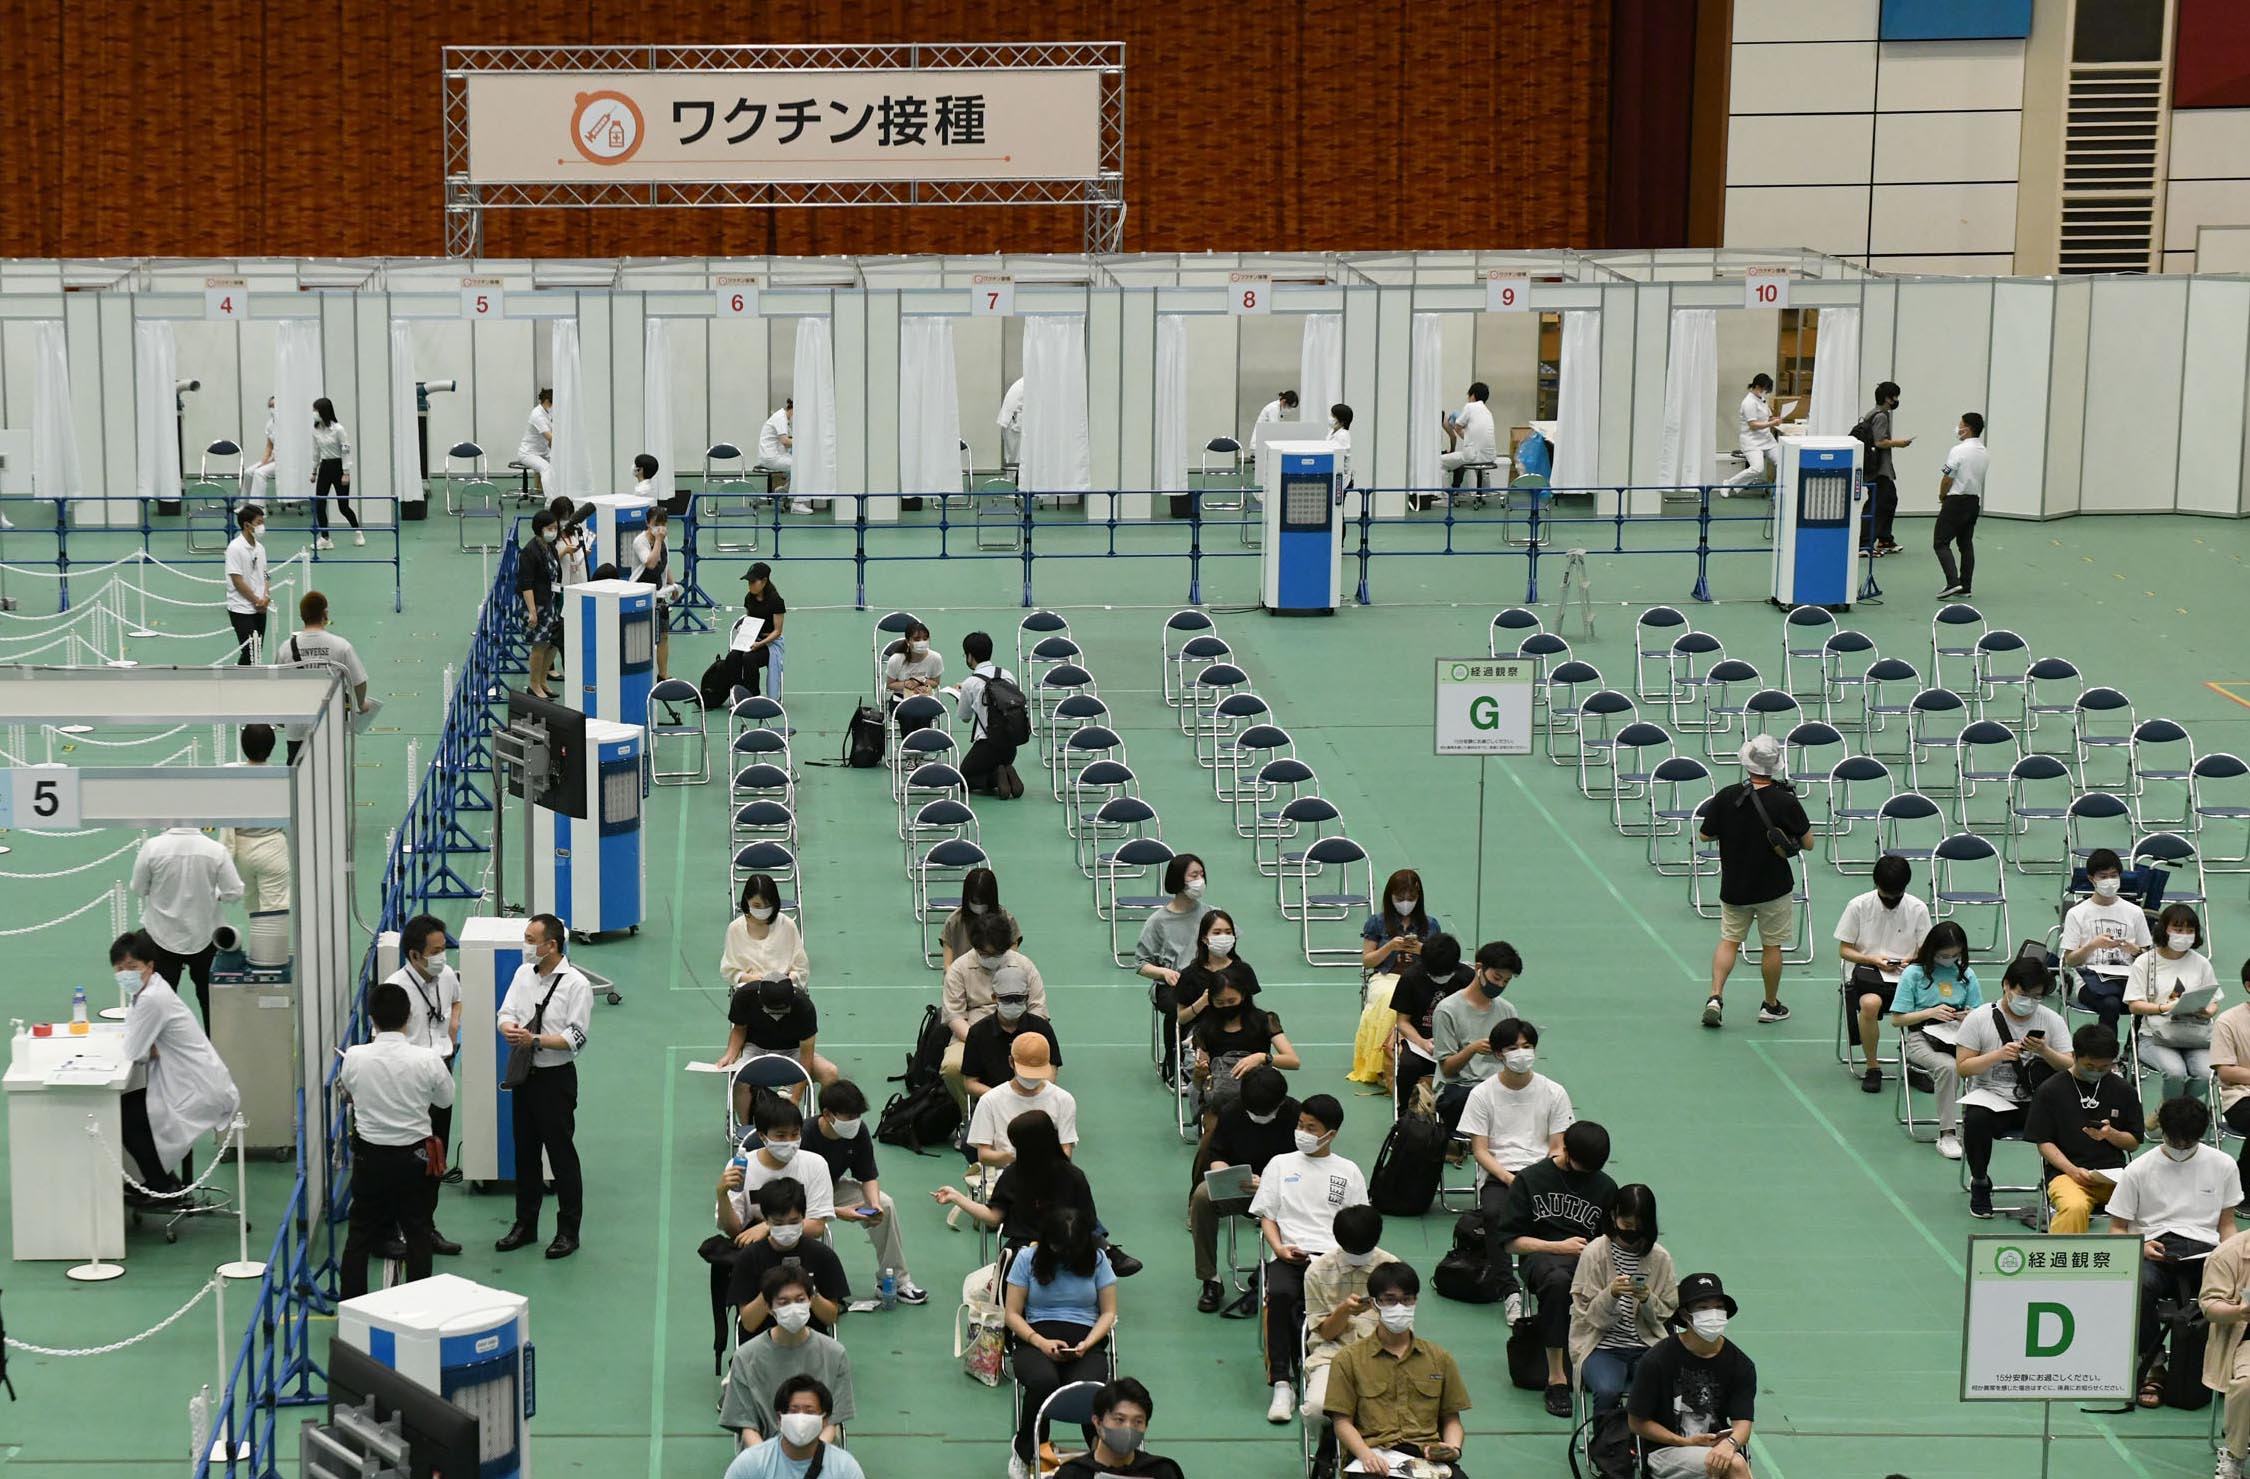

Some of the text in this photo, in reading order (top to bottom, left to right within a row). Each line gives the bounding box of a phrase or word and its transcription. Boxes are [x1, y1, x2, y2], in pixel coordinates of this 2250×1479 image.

[673, 94, 985, 146] ワクチン接種
[987, 292, 999, 310] 7
[1243, 290, 1255, 308] 8
[1502, 288, 1515, 306] 9
[1755, 284, 1777, 302] 10
[220, 296, 233, 314] 4
[476, 295, 489, 313] 5
[731, 294, 744, 312] 6
[1470, 666, 1518, 677] 経過観察
[1469, 695, 1499, 731] G
[33, 780, 59, 817] 5
[1533, 1192, 1602, 1235] AUTIC
[2028, 1251, 2111, 1268] 経過観察
[2025, 1302, 2075, 1357] D
